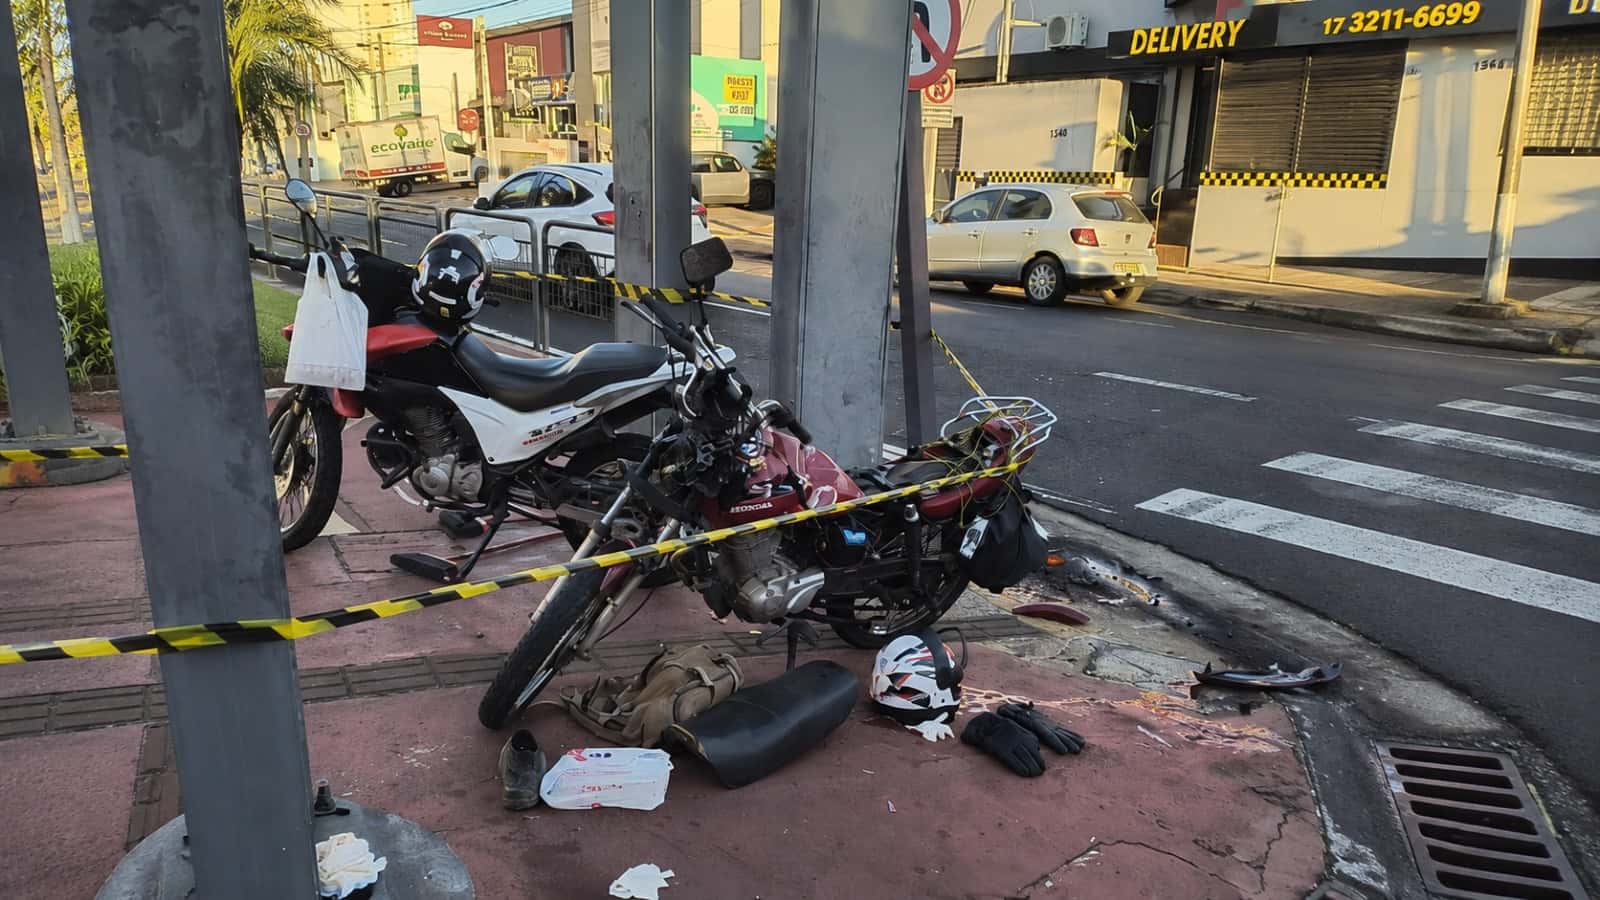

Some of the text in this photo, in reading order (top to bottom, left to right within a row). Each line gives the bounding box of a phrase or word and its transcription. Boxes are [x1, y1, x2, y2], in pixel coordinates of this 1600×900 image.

[1322, 2, 1481, 35] 17 3211-6699
[1129, 19, 1244, 55] DELIVERY
[730, 502, 774, 513] HONDA
